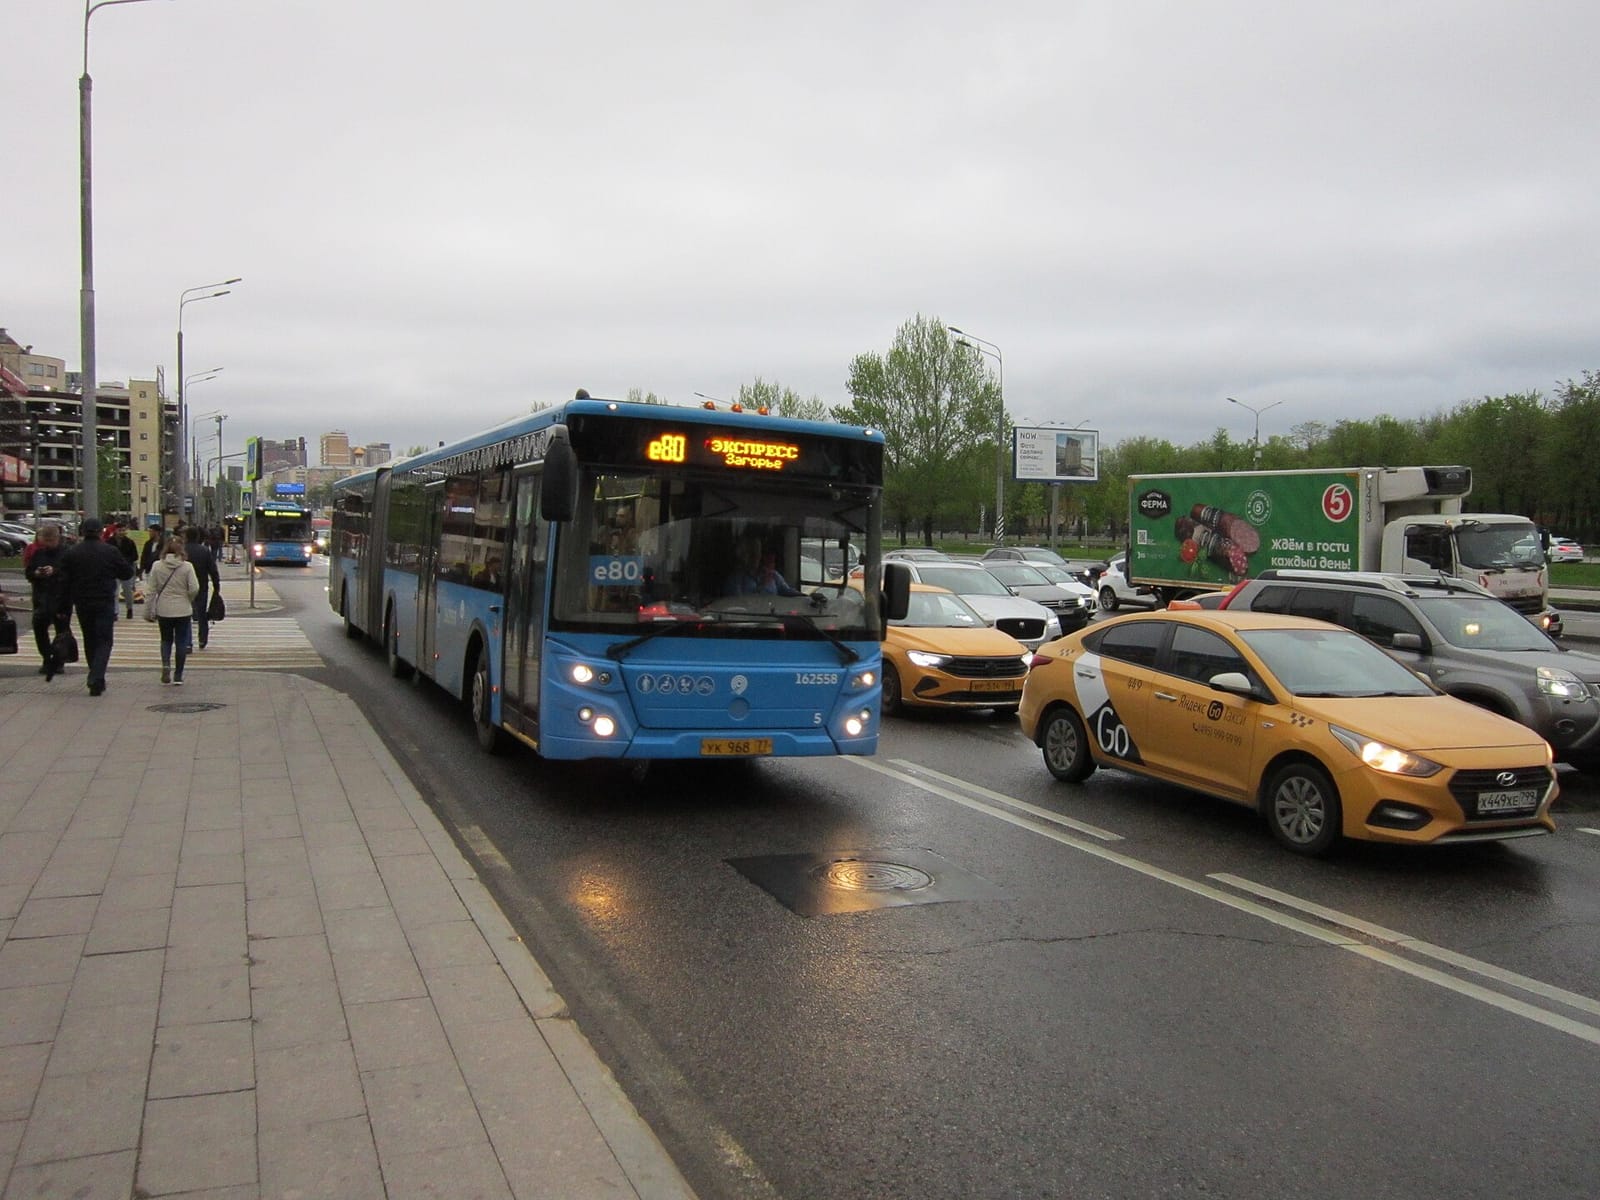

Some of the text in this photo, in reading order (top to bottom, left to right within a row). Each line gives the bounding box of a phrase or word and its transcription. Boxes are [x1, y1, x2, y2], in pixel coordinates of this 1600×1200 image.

[1020, 432, 1037, 440] NOW
[711, 438, 798, 459] ЭКСПРЕСС
[725, 453, 783, 469] Загорье
[1141, 500, 1168, 509] ФЕРМА
[1271, 538, 1350, 553] Ждём в гости
[1271, 556, 1351, 570] каждый день!
[795, 673, 838, 685] 162558
[1128, 678, 1143, 691] 449
[1179, 694, 1247, 726] Яндекс Go Такси
[813, 712, 822, 724] 5
[1097, 706, 1130, 757] Go
[727, 741, 750, 753] 968
